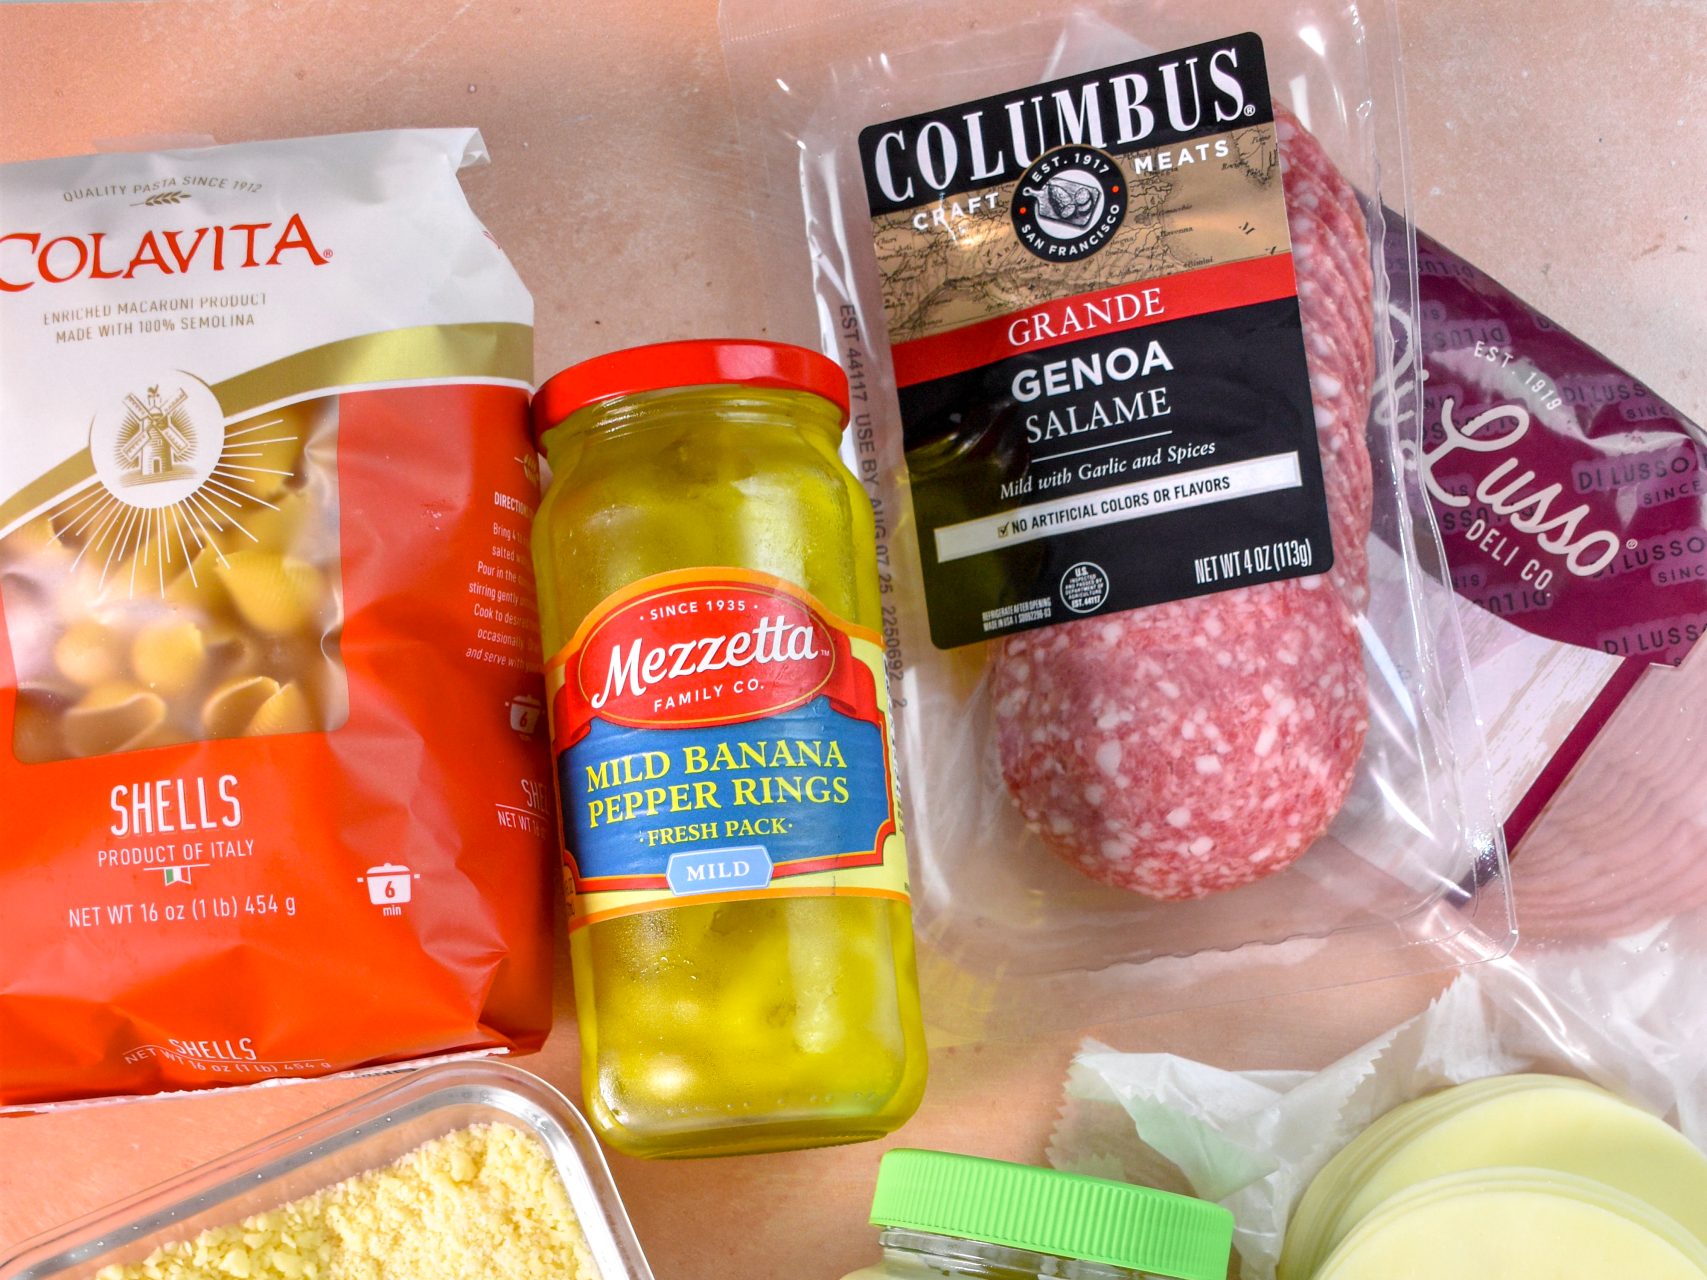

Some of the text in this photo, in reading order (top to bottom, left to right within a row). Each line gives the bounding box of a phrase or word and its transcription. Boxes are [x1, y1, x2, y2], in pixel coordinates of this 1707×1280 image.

[875, 48, 1247, 203] COLUMBUS
[1032, 153, 1109, 183] EST. 1917
[63, 175, 263, 202] QUALITY PASTA SINCE 1912
[913, 140, 1230, 232] CRAFT MEATS
[1022, 205, 1120, 256] SAN FRANCISCO
[43, 292, 267, 326] ENRICHED MACARONI PRODUCT
[840, 304, 857, 339] EST
[1007, 286, 1166, 347] GRANDE
[56, 313, 255, 344] MADE WITH 100% SEMOLINA
[847, 346, 868, 402] 44117
[1011, 340, 1174, 402] GENOA
[1474, 341, 1562, 411] EST. 1919
[1025, 387, 1171, 444] SALAME
[855, 413, 874, 455] USE
[860, 461, 879, 486] BY
[1001, 439, 1216, 500] Mild with Garlic and Spices
[1400, 397, 1620, 576] Lusso
[1579, 457, 1690, 490] DI LUSSO
[1011, 476, 1230, 534] NO ARTIFICIAL COLORS OR FLAVORS
[478, 560, 495, 577] Pour
[1195, 539, 1313, 584] NET WT 4 OZ (113g)
[1465, 520, 1553, 597] DELI CO.
[469, 581, 496, 601] stirring
[474, 603, 493, 620] Cook
[650, 600, 746, 620] SINCE 1935
[484, 651, 506, 666] serve
[591, 615, 818, 709] Mezzetta
[653, 679, 765, 713] FAMILY CO.
[585, 740, 848, 793] MILD BANANA
[110, 774, 243, 837] SHELLS
[497, 810, 516, 828] NET
[588, 776, 850, 830] PEPPER RINGS
[98, 840, 254, 867] PRODUCT OF ITALY
[686, 861, 750, 882] MILD
[69, 894, 296, 928] NET WT 16 oz 454 g
[383, 905, 401, 916] min
[124, 1047, 205, 1071] NET WT 16
[168, 1037, 257, 1061] SHELLS
